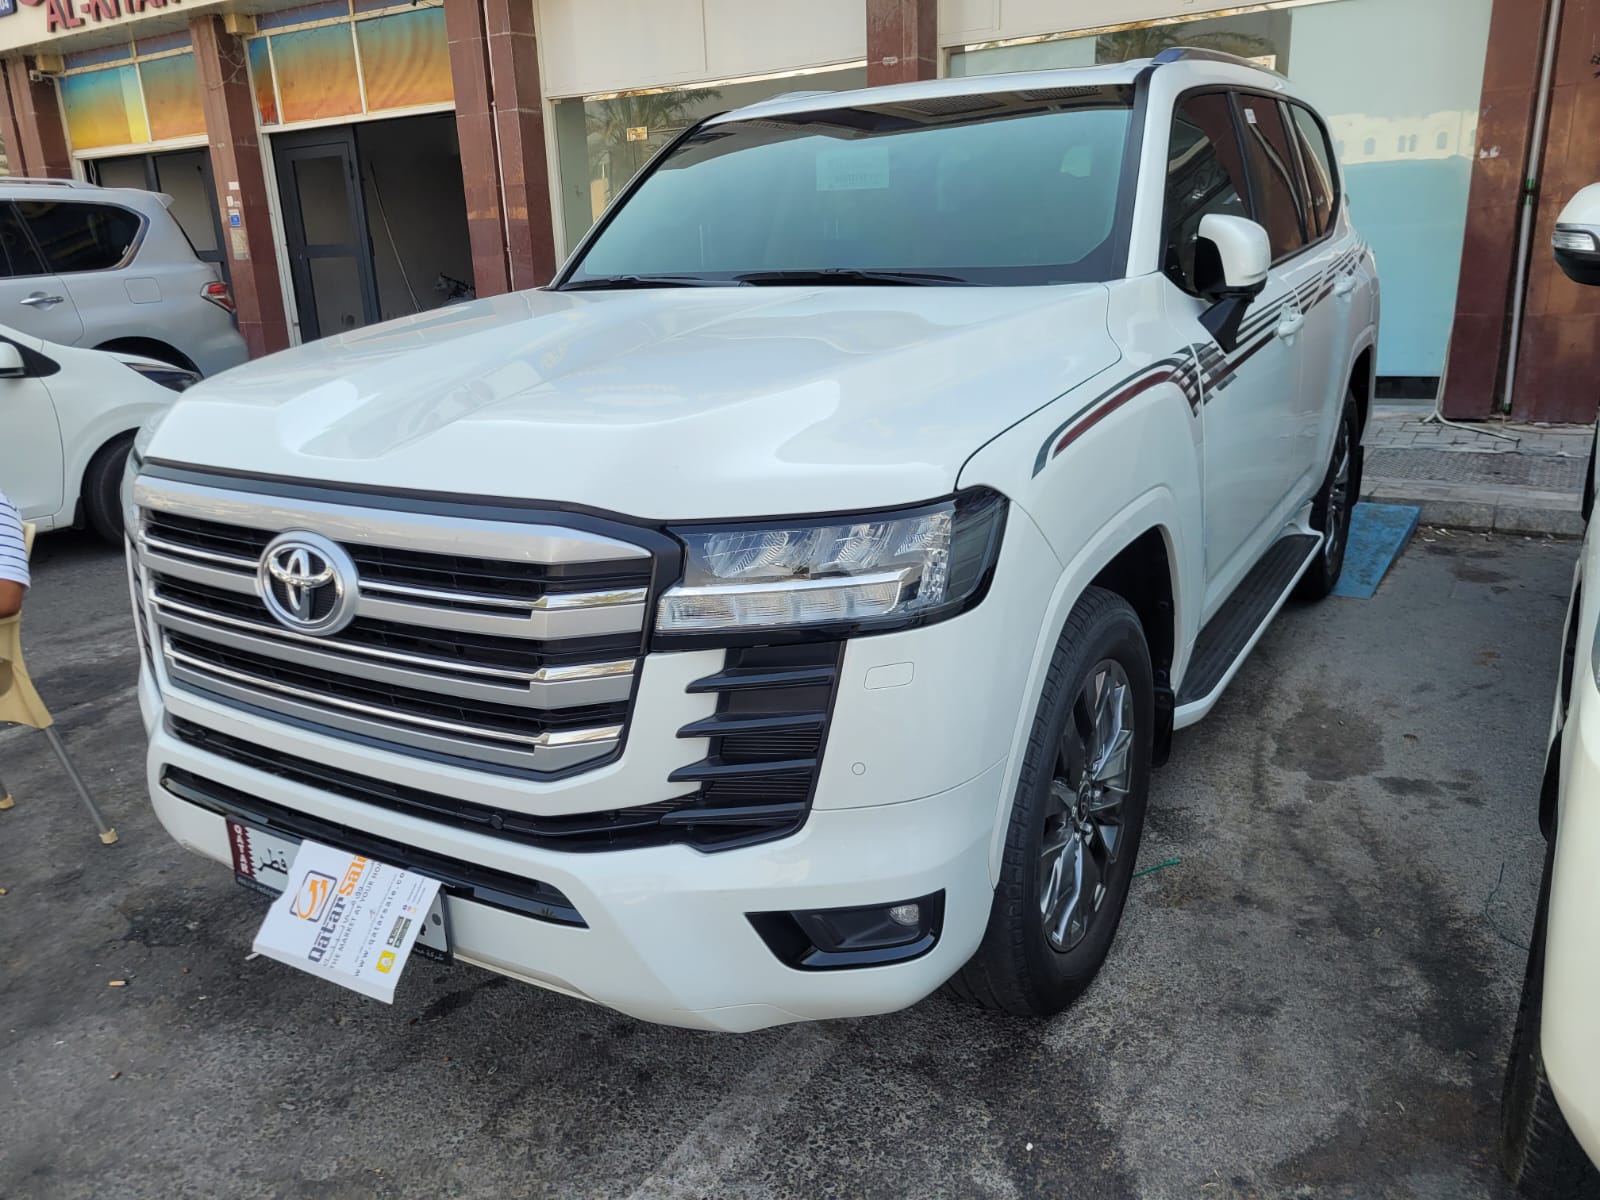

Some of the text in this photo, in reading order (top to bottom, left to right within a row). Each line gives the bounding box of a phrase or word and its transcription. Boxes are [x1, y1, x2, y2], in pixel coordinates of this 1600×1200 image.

[233, 824, 250, 874] QATAR
[330, 954, 341, 968] THE
[338, 917, 357, 952] MARKET
[360, 881, 374, 903] YOUR
